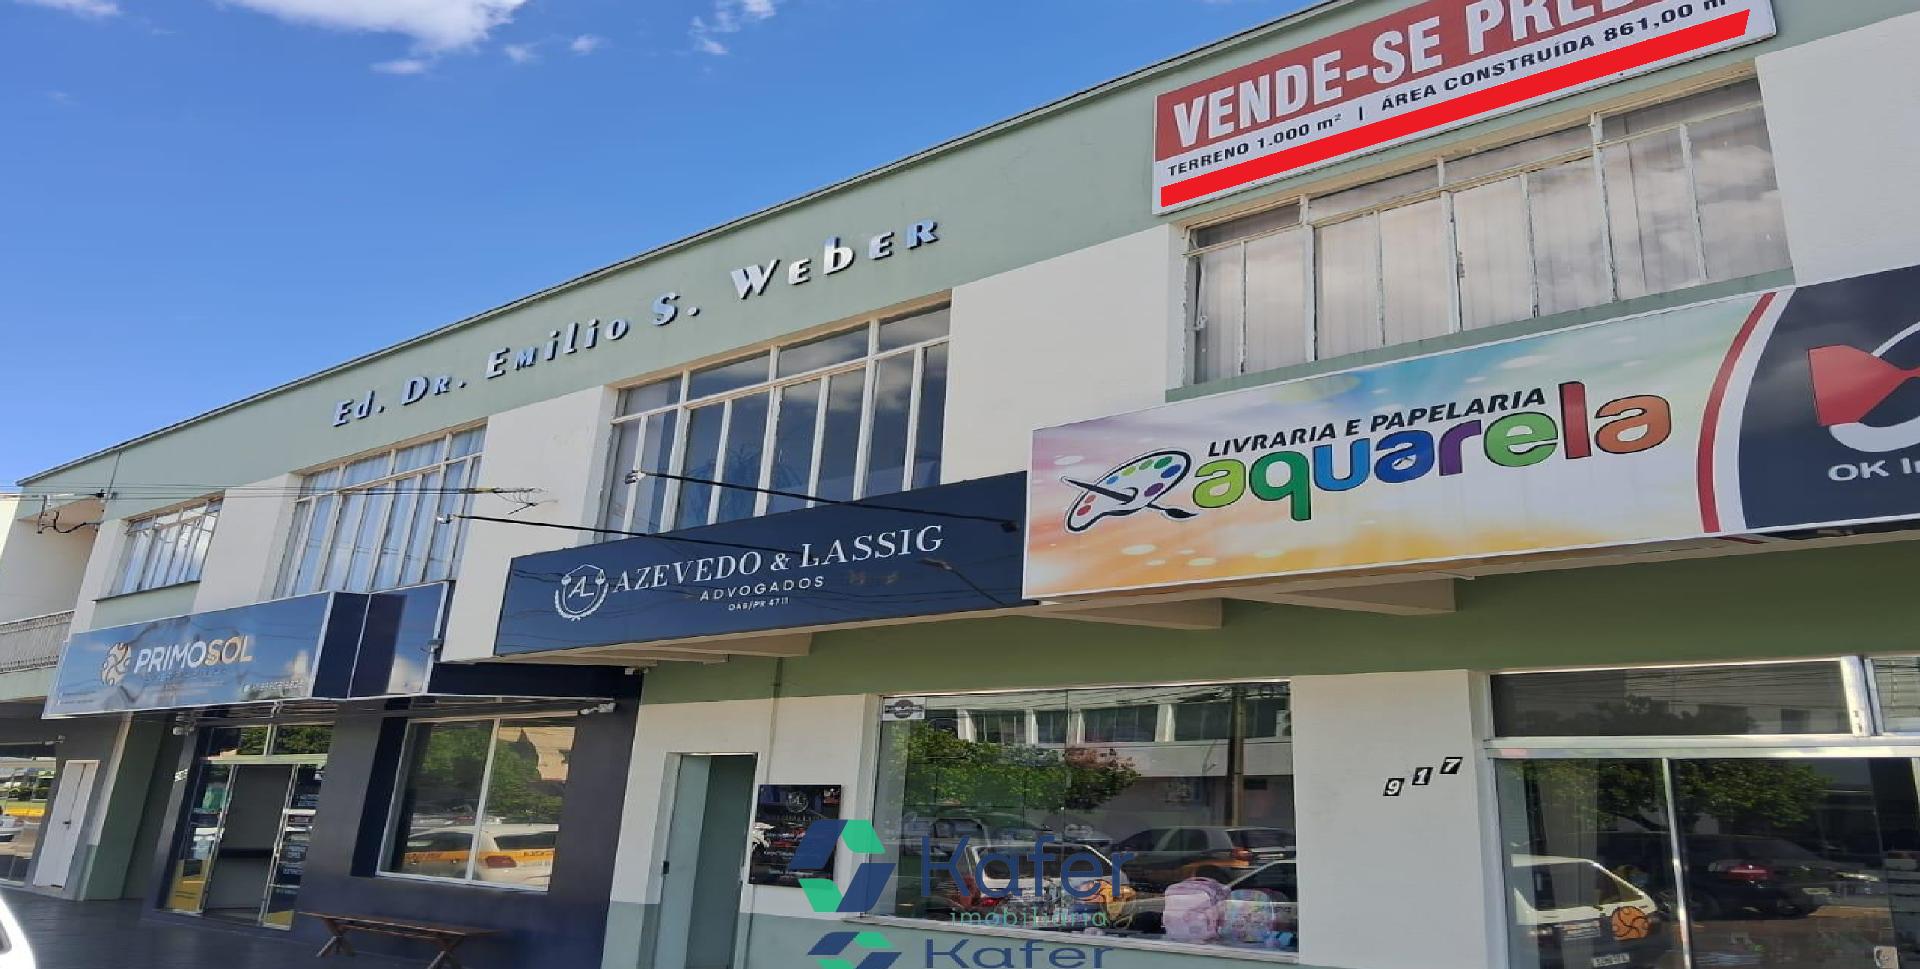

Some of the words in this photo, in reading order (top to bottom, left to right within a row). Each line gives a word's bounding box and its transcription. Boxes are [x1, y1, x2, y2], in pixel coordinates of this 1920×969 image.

[1168, 143, 1249, 176] TERRENO
[1257, 123, 1310, 149] 1.000
[1381, 83, 1437, 111] ÁREA
[1445, 34, 1595, 91] CONSTRUÍDA
[1604, 3, 1693, 42] 861,00
[1173, 15, 1442, 148] VENDE-SE
[333, 390, 385, 427] Ed.
[652, 292, 700, 326] S.
[1192, 381, 1671, 521] aquarela
[1208, 424, 1336, 457] LIVRARIA
[1345, 419, 1361, 436] E
[1370, 388, 1546, 433] PAPELARIA
[1828, 460, 1890, 481] OK
[613, 551, 762, 593] AZEVEDO
[770, 552, 791, 571] &
[799, 525, 943, 568] LASSIG
[700, 575, 824, 601] ADVOGADOS
[134, 636, 253, 673] PRIMOSOL
